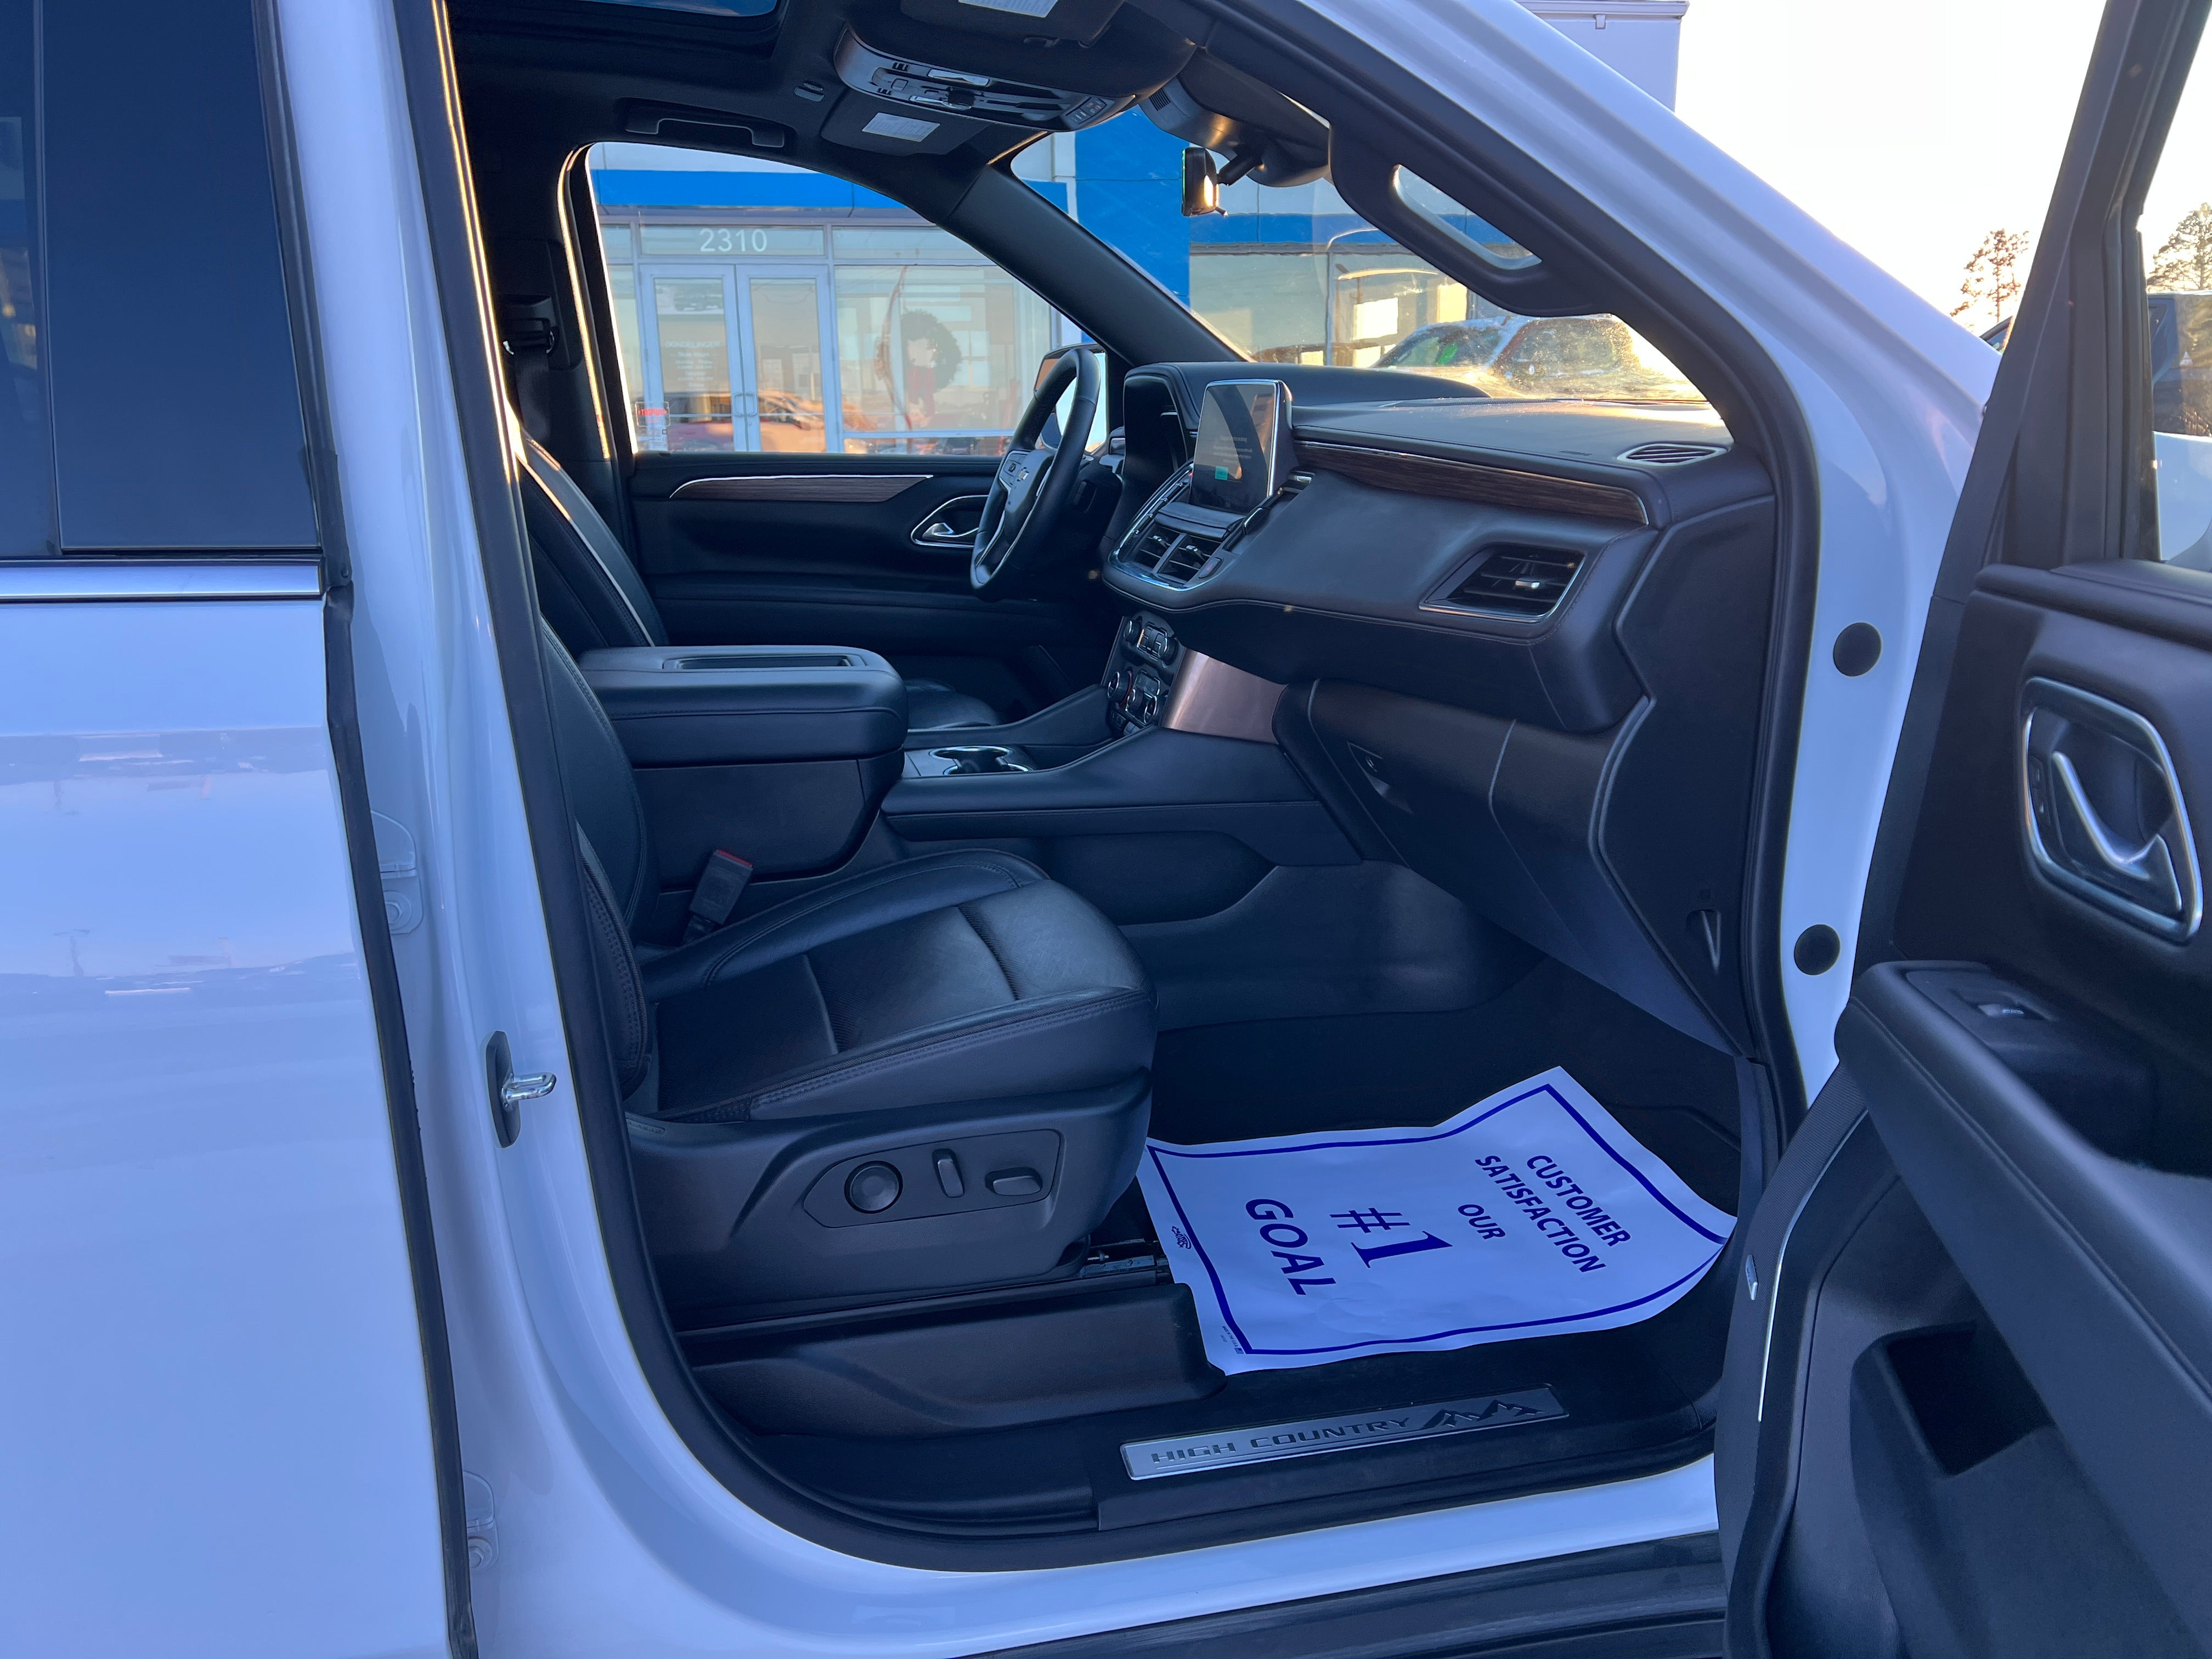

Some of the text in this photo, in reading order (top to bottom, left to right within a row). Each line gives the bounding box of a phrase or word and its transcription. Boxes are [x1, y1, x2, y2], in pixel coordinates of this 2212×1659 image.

[699, 228, 768, 252] 2310
[1458, 1204, 1506, 1240] OUR
[1475, 1155, 1606, 1273] SATISFACTION
[1527, 1155, 1631, 1248] CUSTOMER
[1245, 1199, 1336, 1295] GOAL
[1329, 1207, 1453, 1268] #1
[1152, 1418, 1410, 1463] HIGH COUNTRY
